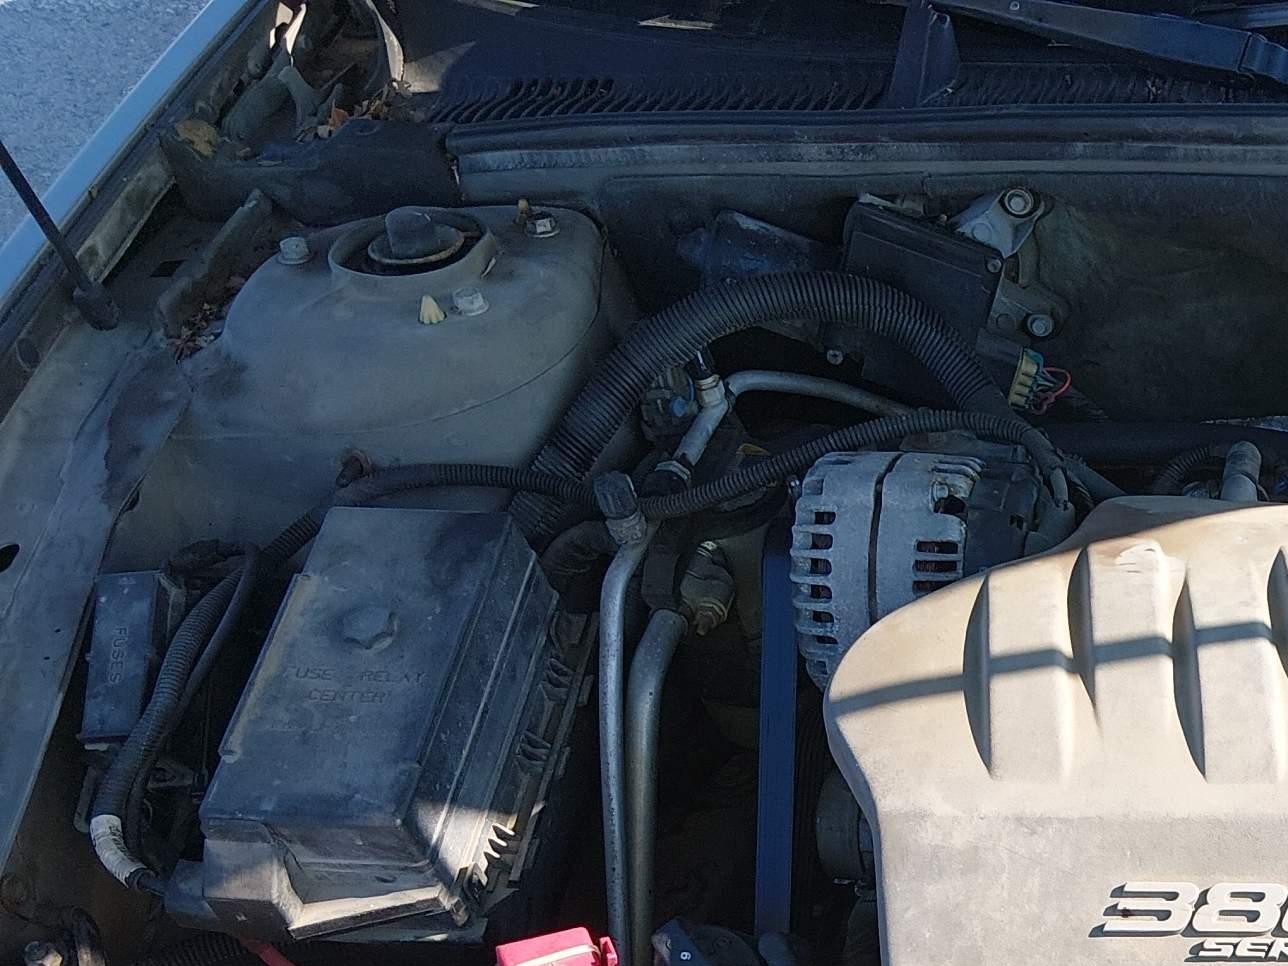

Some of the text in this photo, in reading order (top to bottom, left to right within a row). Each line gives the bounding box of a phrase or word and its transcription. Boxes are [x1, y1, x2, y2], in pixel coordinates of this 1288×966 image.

[283, 666, 335, 680] FUSE
[308, 689, 386, 702] CENTER
[680, 952, 691, 960] 6
